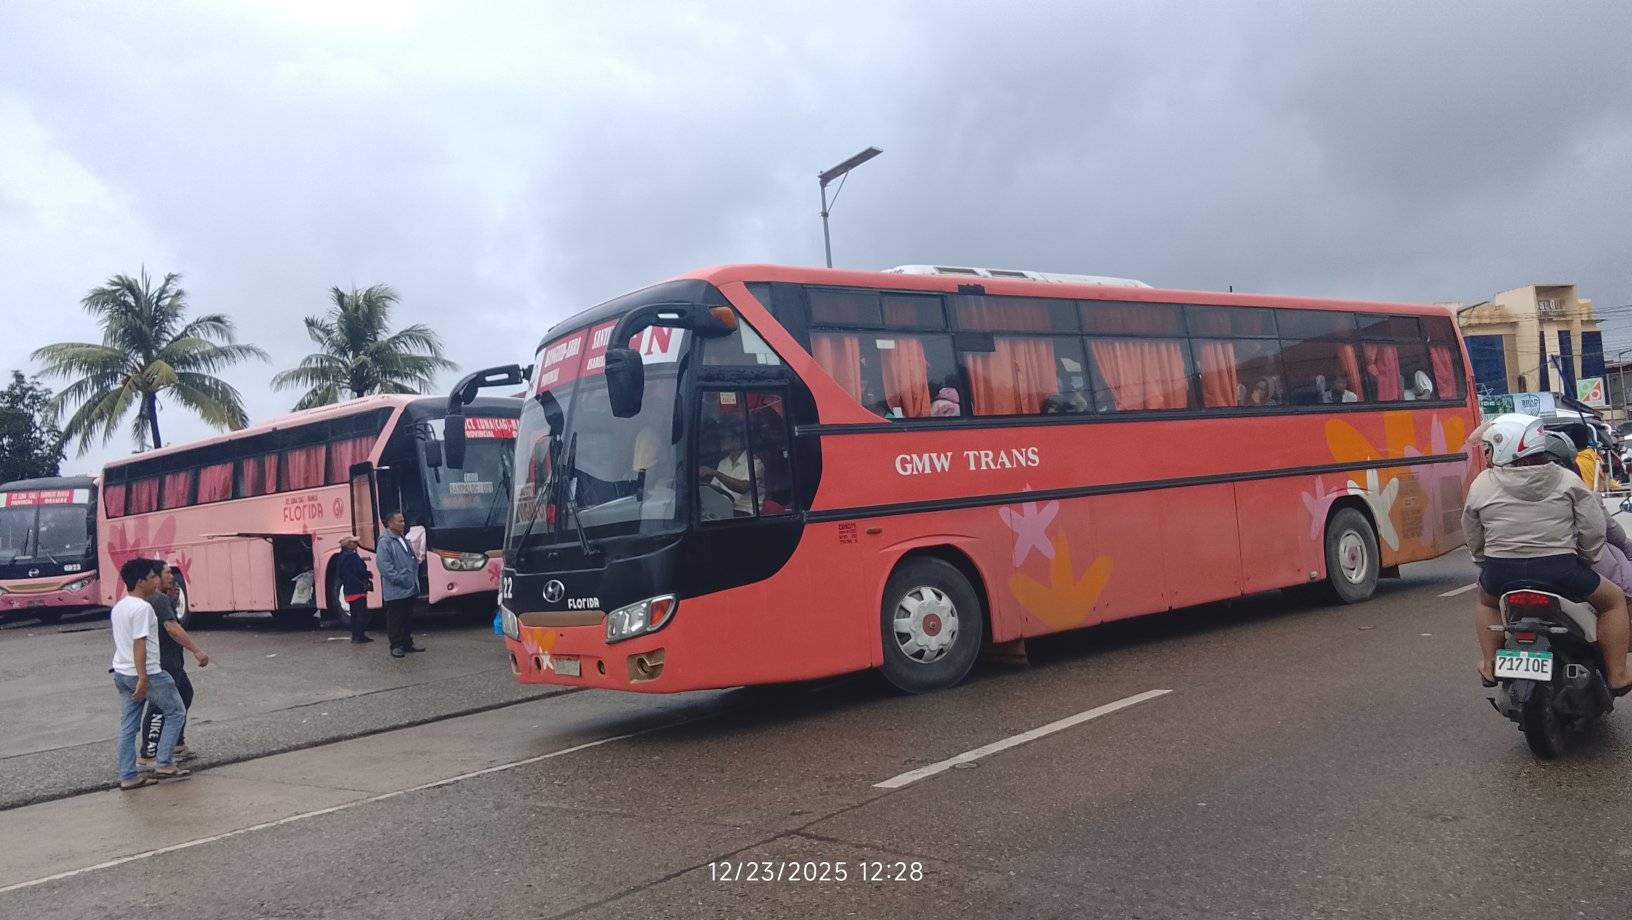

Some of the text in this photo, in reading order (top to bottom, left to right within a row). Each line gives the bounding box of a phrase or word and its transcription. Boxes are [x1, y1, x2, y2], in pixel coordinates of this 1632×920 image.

[895, 447, 1040, 476] GMW TRANS
[567, 597, 600, 609] FLORIDA
[149, 714, 162, 738] NIKE
